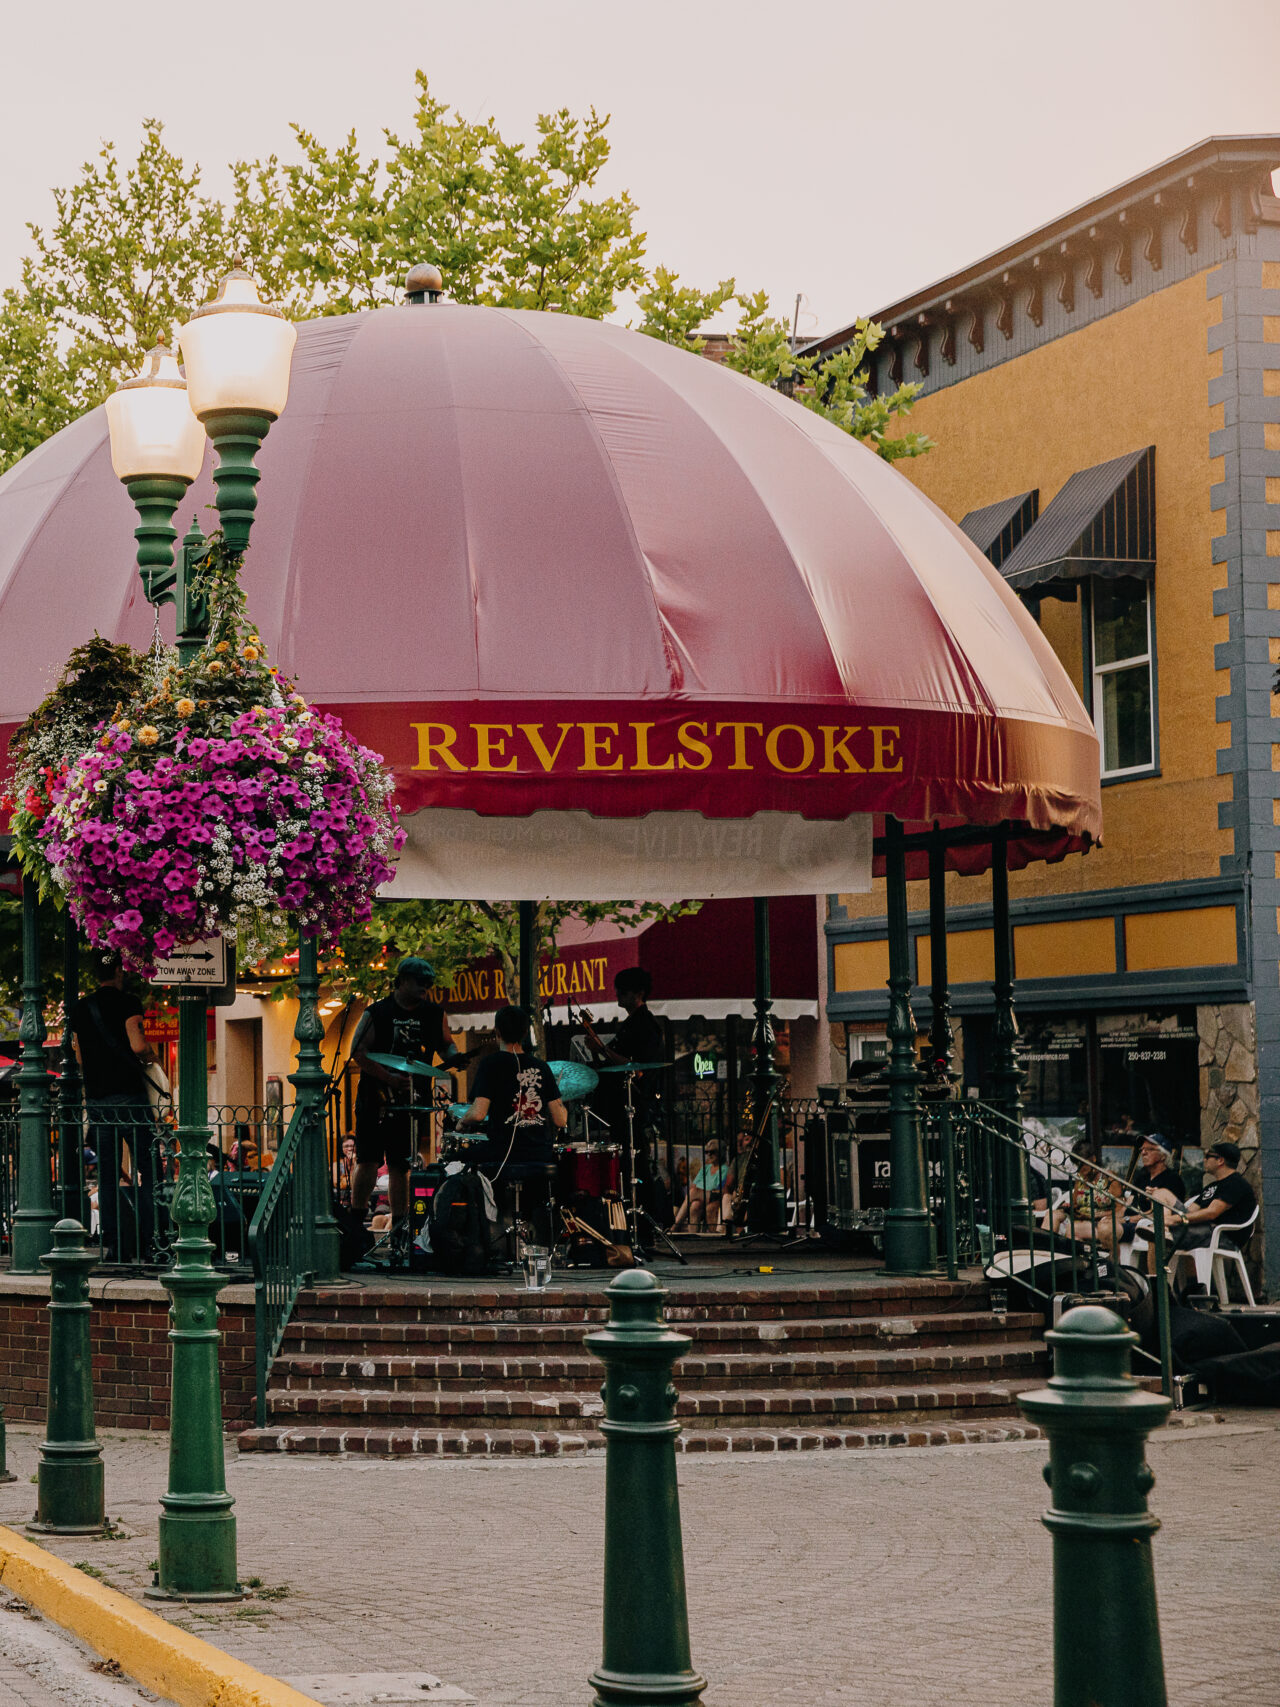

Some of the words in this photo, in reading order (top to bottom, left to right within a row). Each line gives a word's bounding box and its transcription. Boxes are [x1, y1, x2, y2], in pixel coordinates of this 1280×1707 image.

[410, 720, 904, 774] REVELSTOKE
[160, 967, 175, 975] TOW
[176, 967, 196, 976] AWAY
[197, 967, 216, 976] ZONE
[448, 969, 489, 1003] KONG
[694, 1053, 714, 1079] Open
